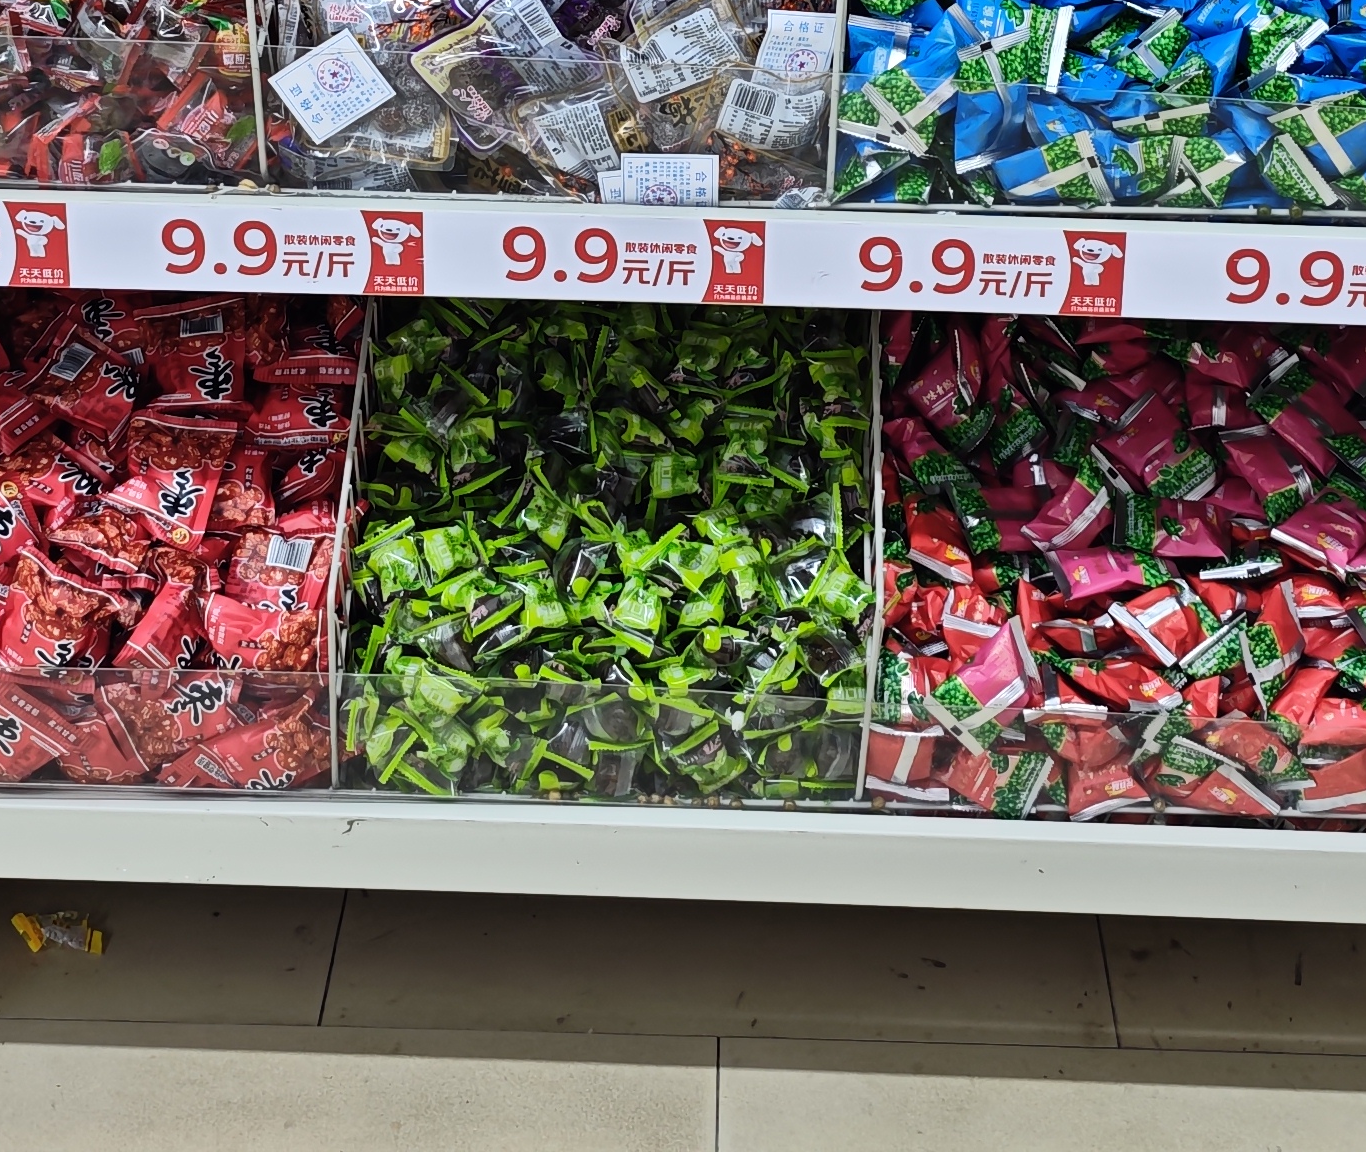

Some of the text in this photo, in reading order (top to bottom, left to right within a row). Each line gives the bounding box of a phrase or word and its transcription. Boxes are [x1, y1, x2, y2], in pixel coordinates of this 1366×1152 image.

[784, 19, 825, 35] 合格证
[289, 81, 324, 125] 合格证
[162, 219, 277, 275] 9.9
[283, 234, 356, 247] 散装休闲零食
[624, 241, 698, 255] 散装休闲零食
[282, 251, 355, 278] 元/斤
[503, 226, 618, 283] 9.9
[982, 252, 1057, 267] 散装休闲零食
[18, 268, 64, 278] 天天低价
[623, 259, 695, 286] 元/斤
[859, 237, 975, 295] 9.9
[373, 276, 419, 286] 天天低价
[979, 271, 1053, 298] 元/斤
[1226, 249, 1344, 306] 9.9
[712, 284, 759, 295] 天天低价
[1069, 296, 1117, 307] 天天低价
